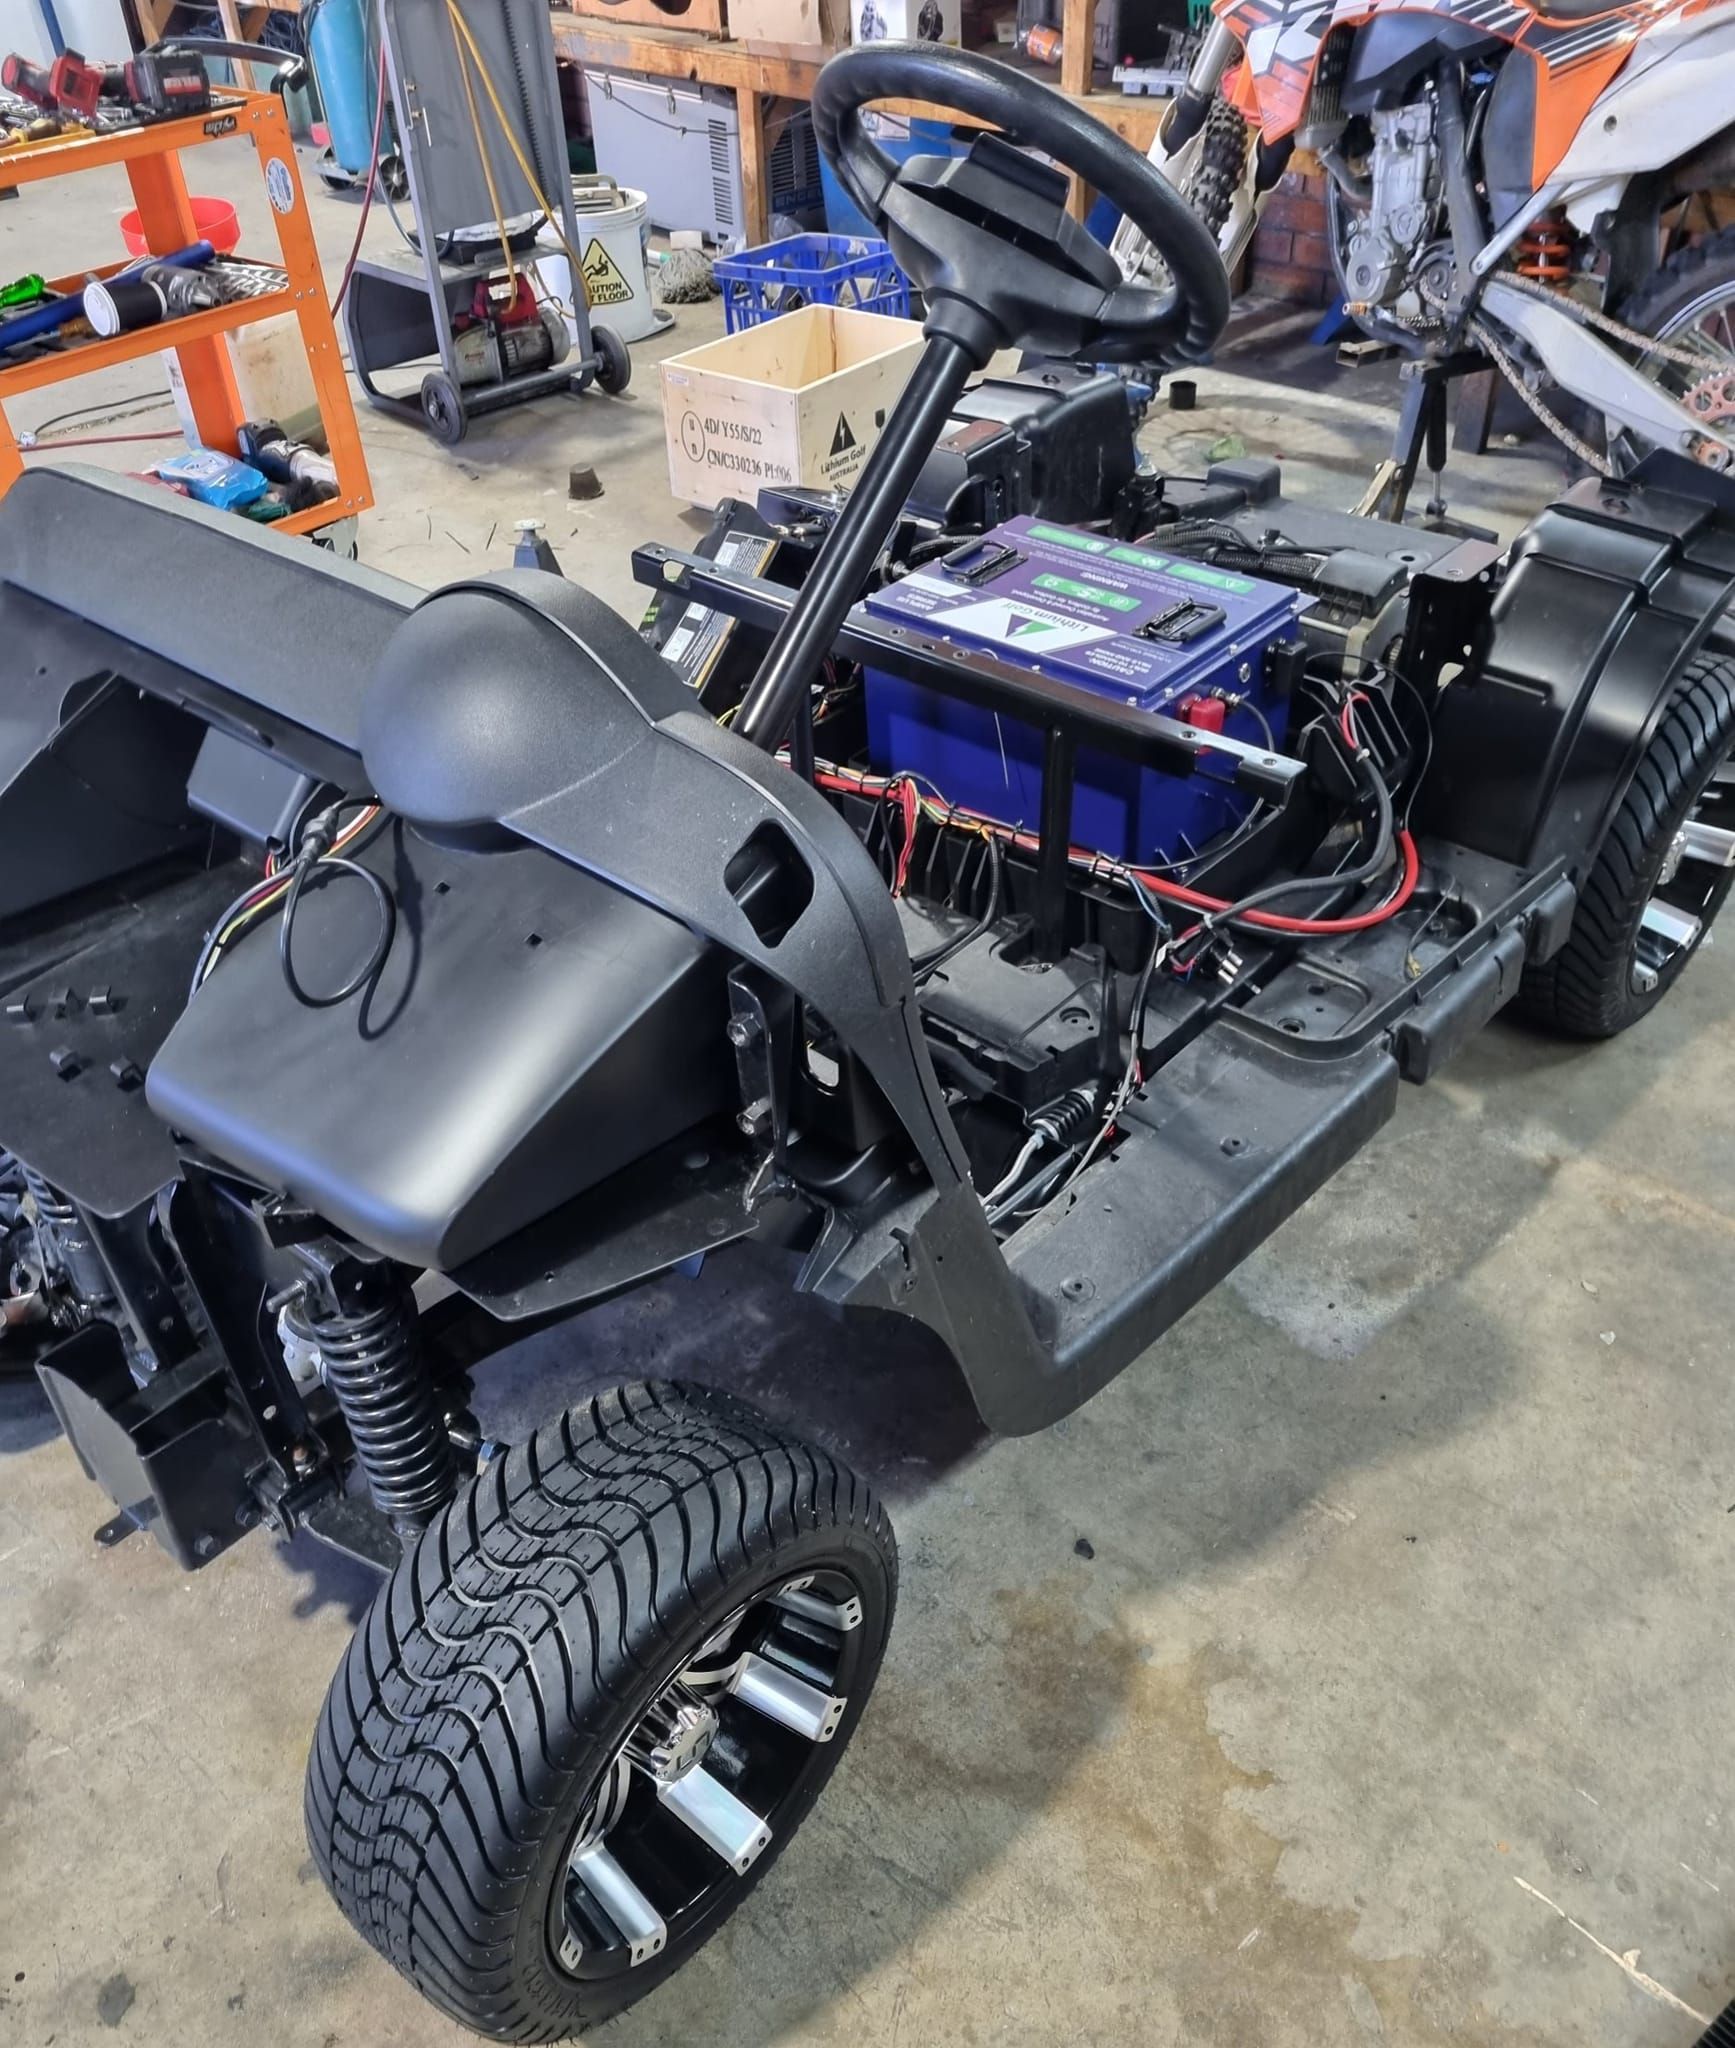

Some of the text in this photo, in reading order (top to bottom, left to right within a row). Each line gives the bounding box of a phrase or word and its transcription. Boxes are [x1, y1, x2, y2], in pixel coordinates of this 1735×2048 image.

[598, 290, 629, 303] FLOOR
[820, 444, 866, 475] Lithium Golf
[829, 463, 859, 481] AUSTRALIA
[1003, 602, 1088, 632] Lithium Golf
